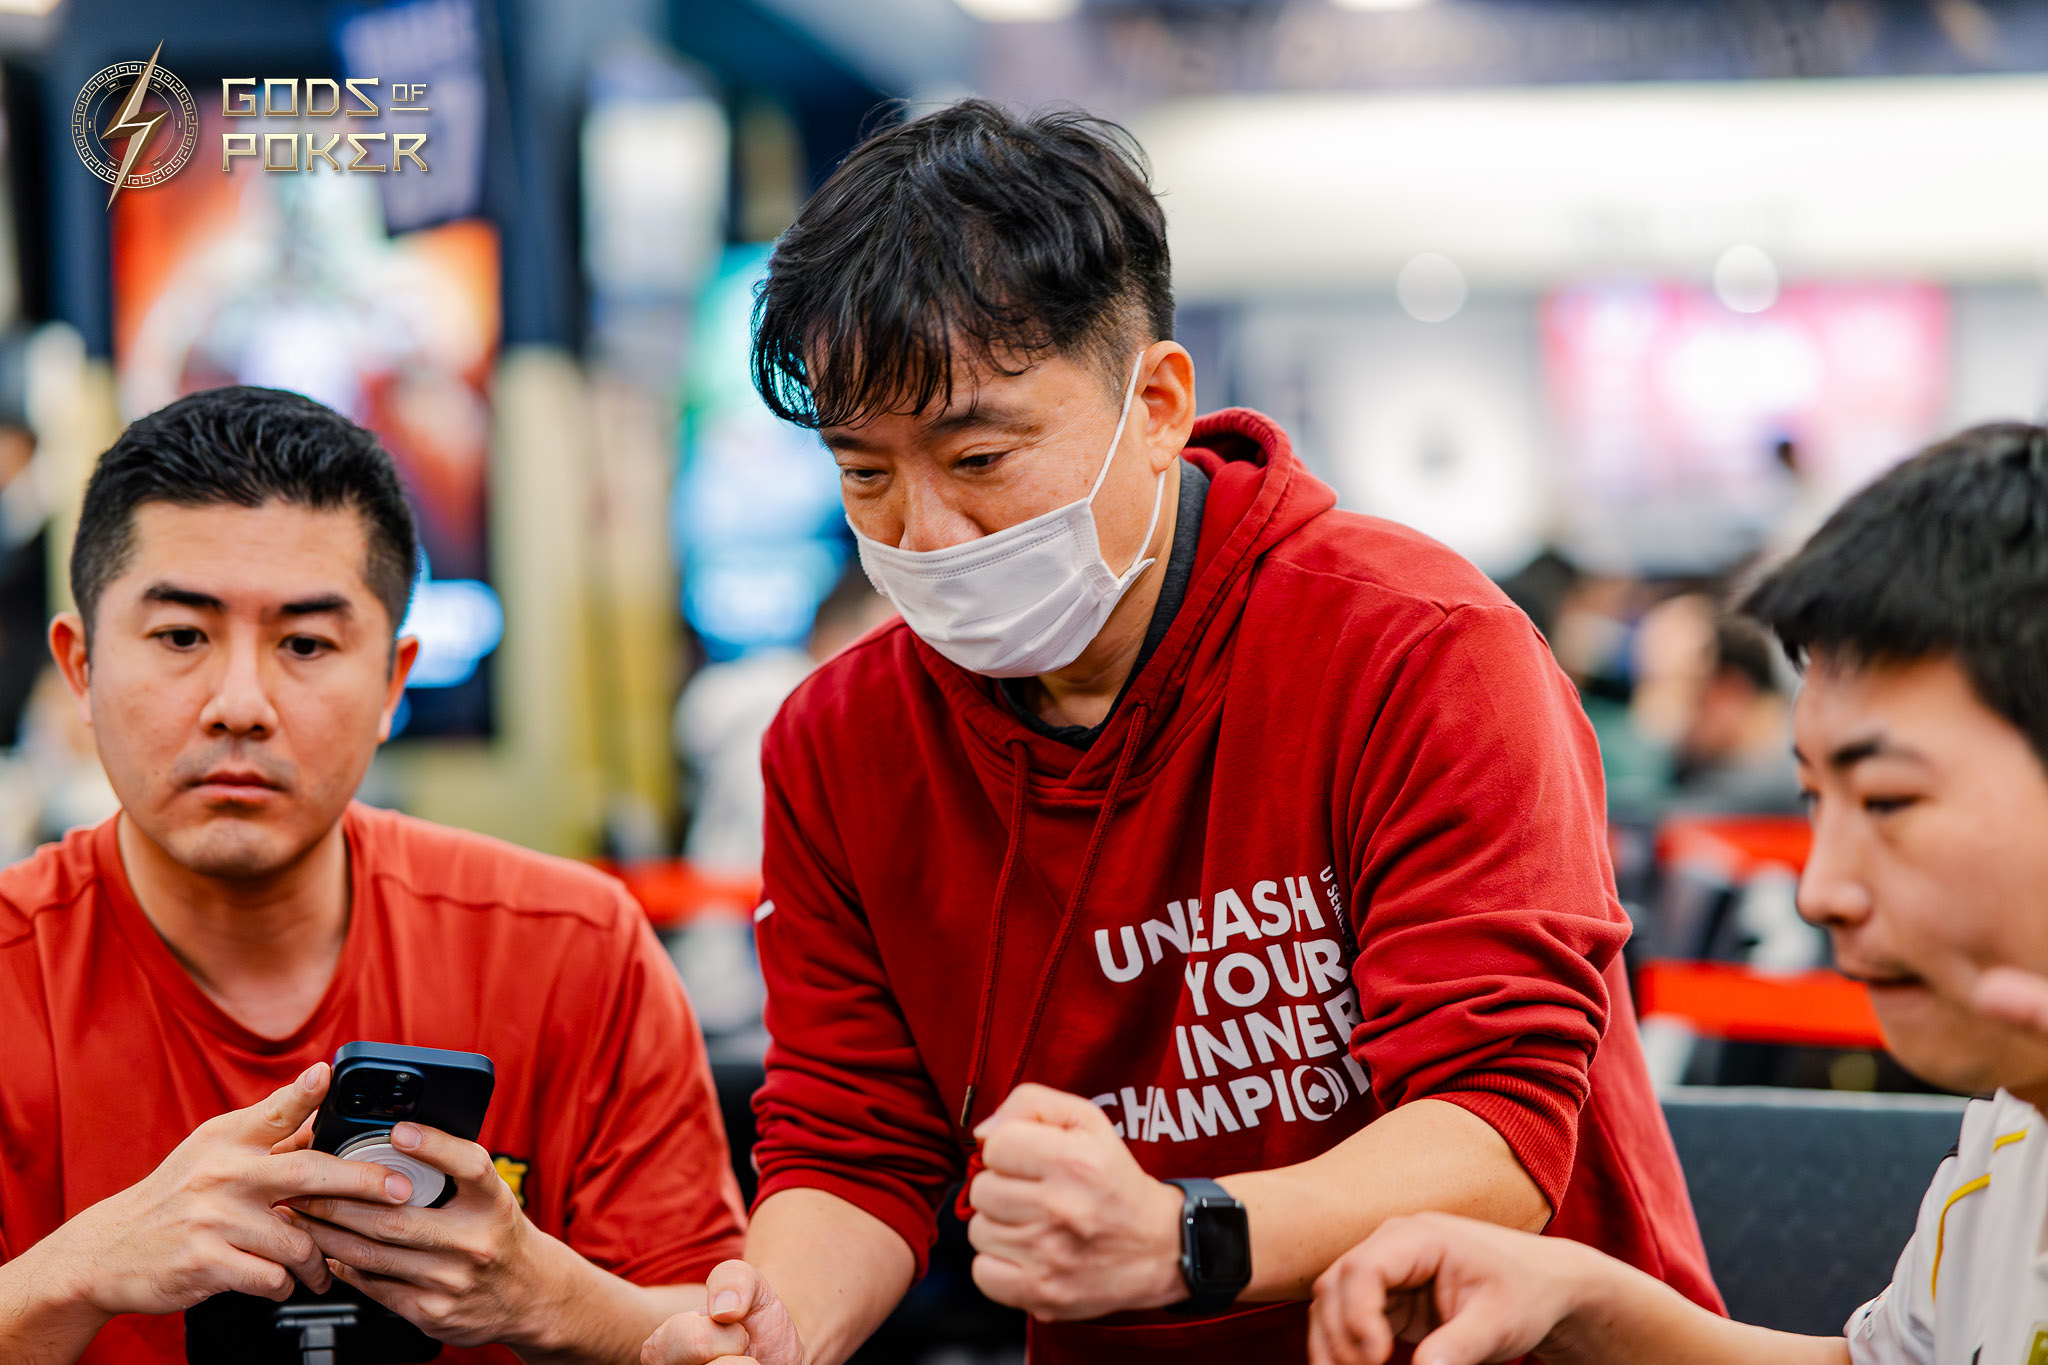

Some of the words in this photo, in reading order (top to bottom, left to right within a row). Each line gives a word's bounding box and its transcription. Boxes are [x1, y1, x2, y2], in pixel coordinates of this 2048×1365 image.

[1319, 865, 1334, 882] U
[1184, 938, 1349, 1016] YOUR
[1175, 987, 1361, 1080] INNER
